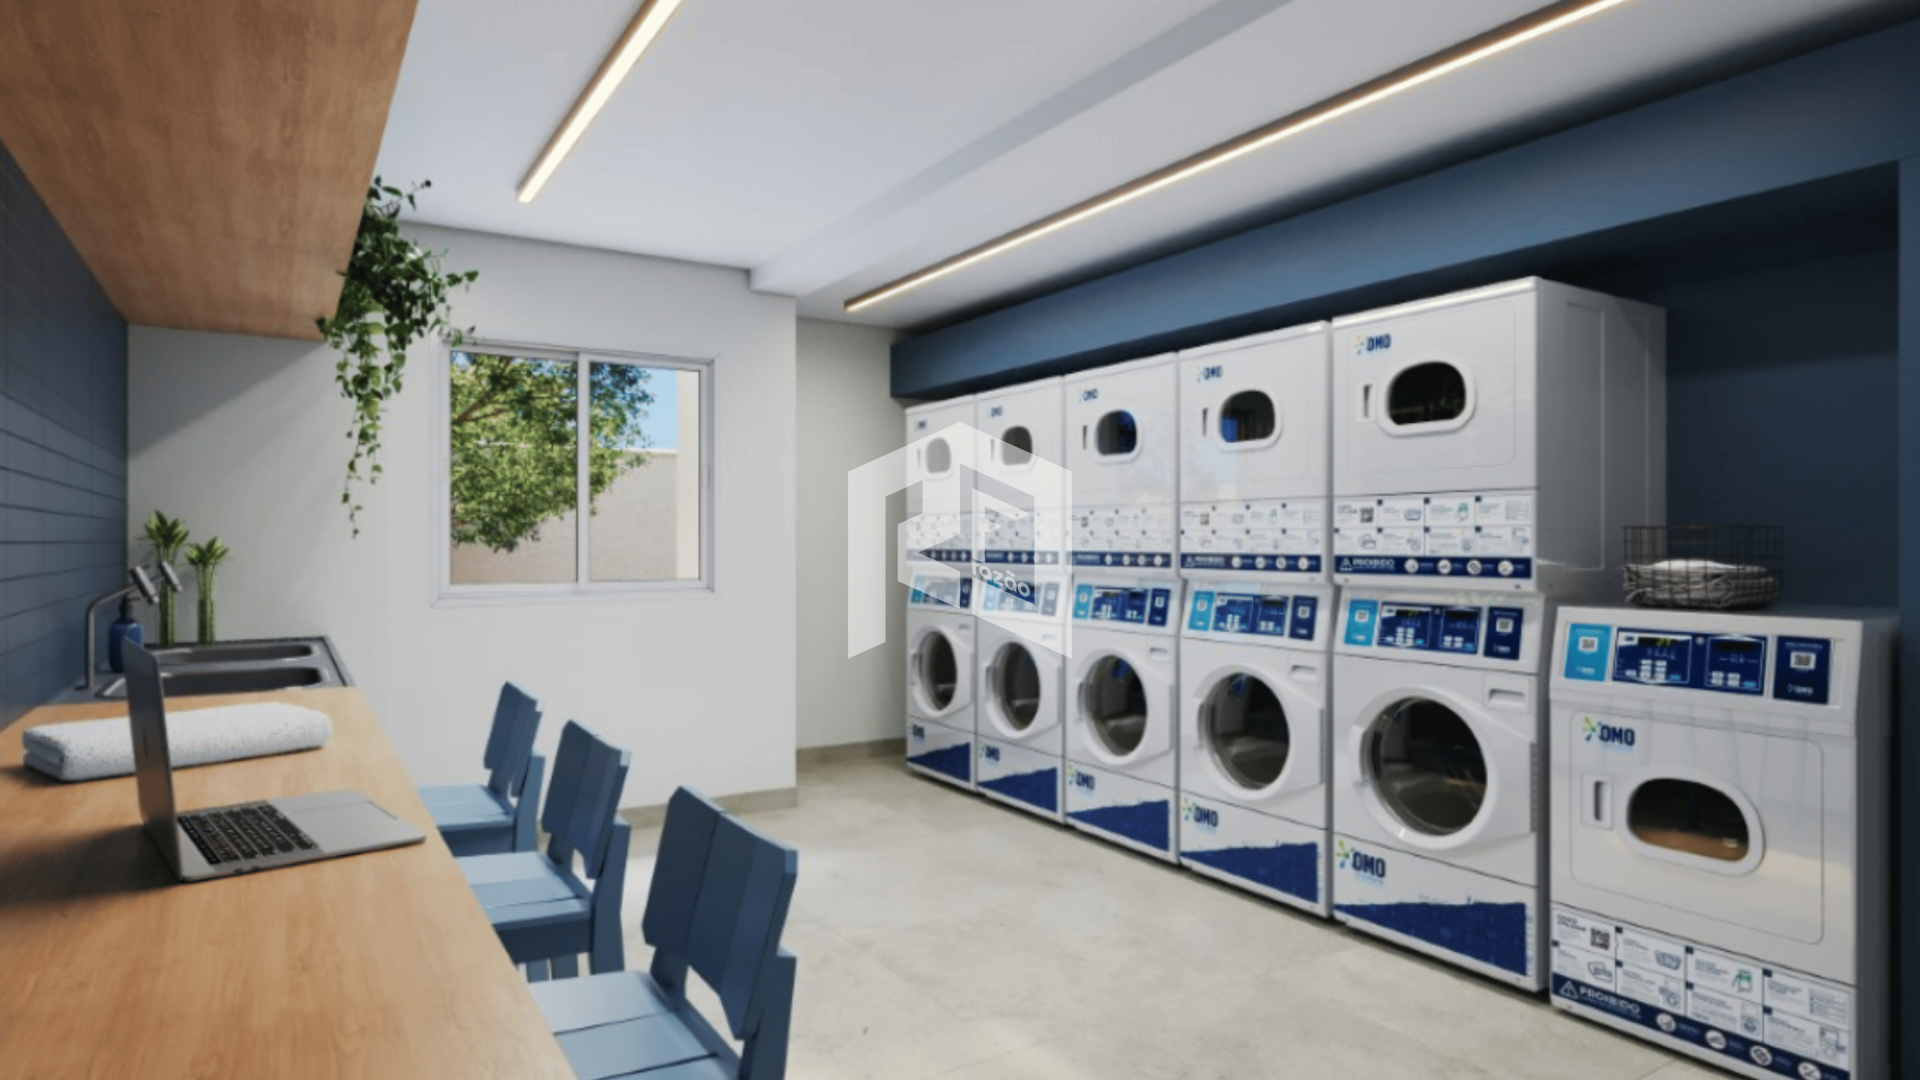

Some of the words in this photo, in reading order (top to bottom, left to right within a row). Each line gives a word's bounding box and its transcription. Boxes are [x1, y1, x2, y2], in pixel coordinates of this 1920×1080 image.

[1366, 334, 1391, 351] OMO
[1203, 365, 1222, 380] OMO
[1599, 724, 1635, 746] OMO
[1076, 771, 1094, 790] OMO
[1192, 806, 1218, 828] OMO
[1351, 850, 1386, 878] OMO
[1580, 986, 1641, 1014] PROIBIDO
